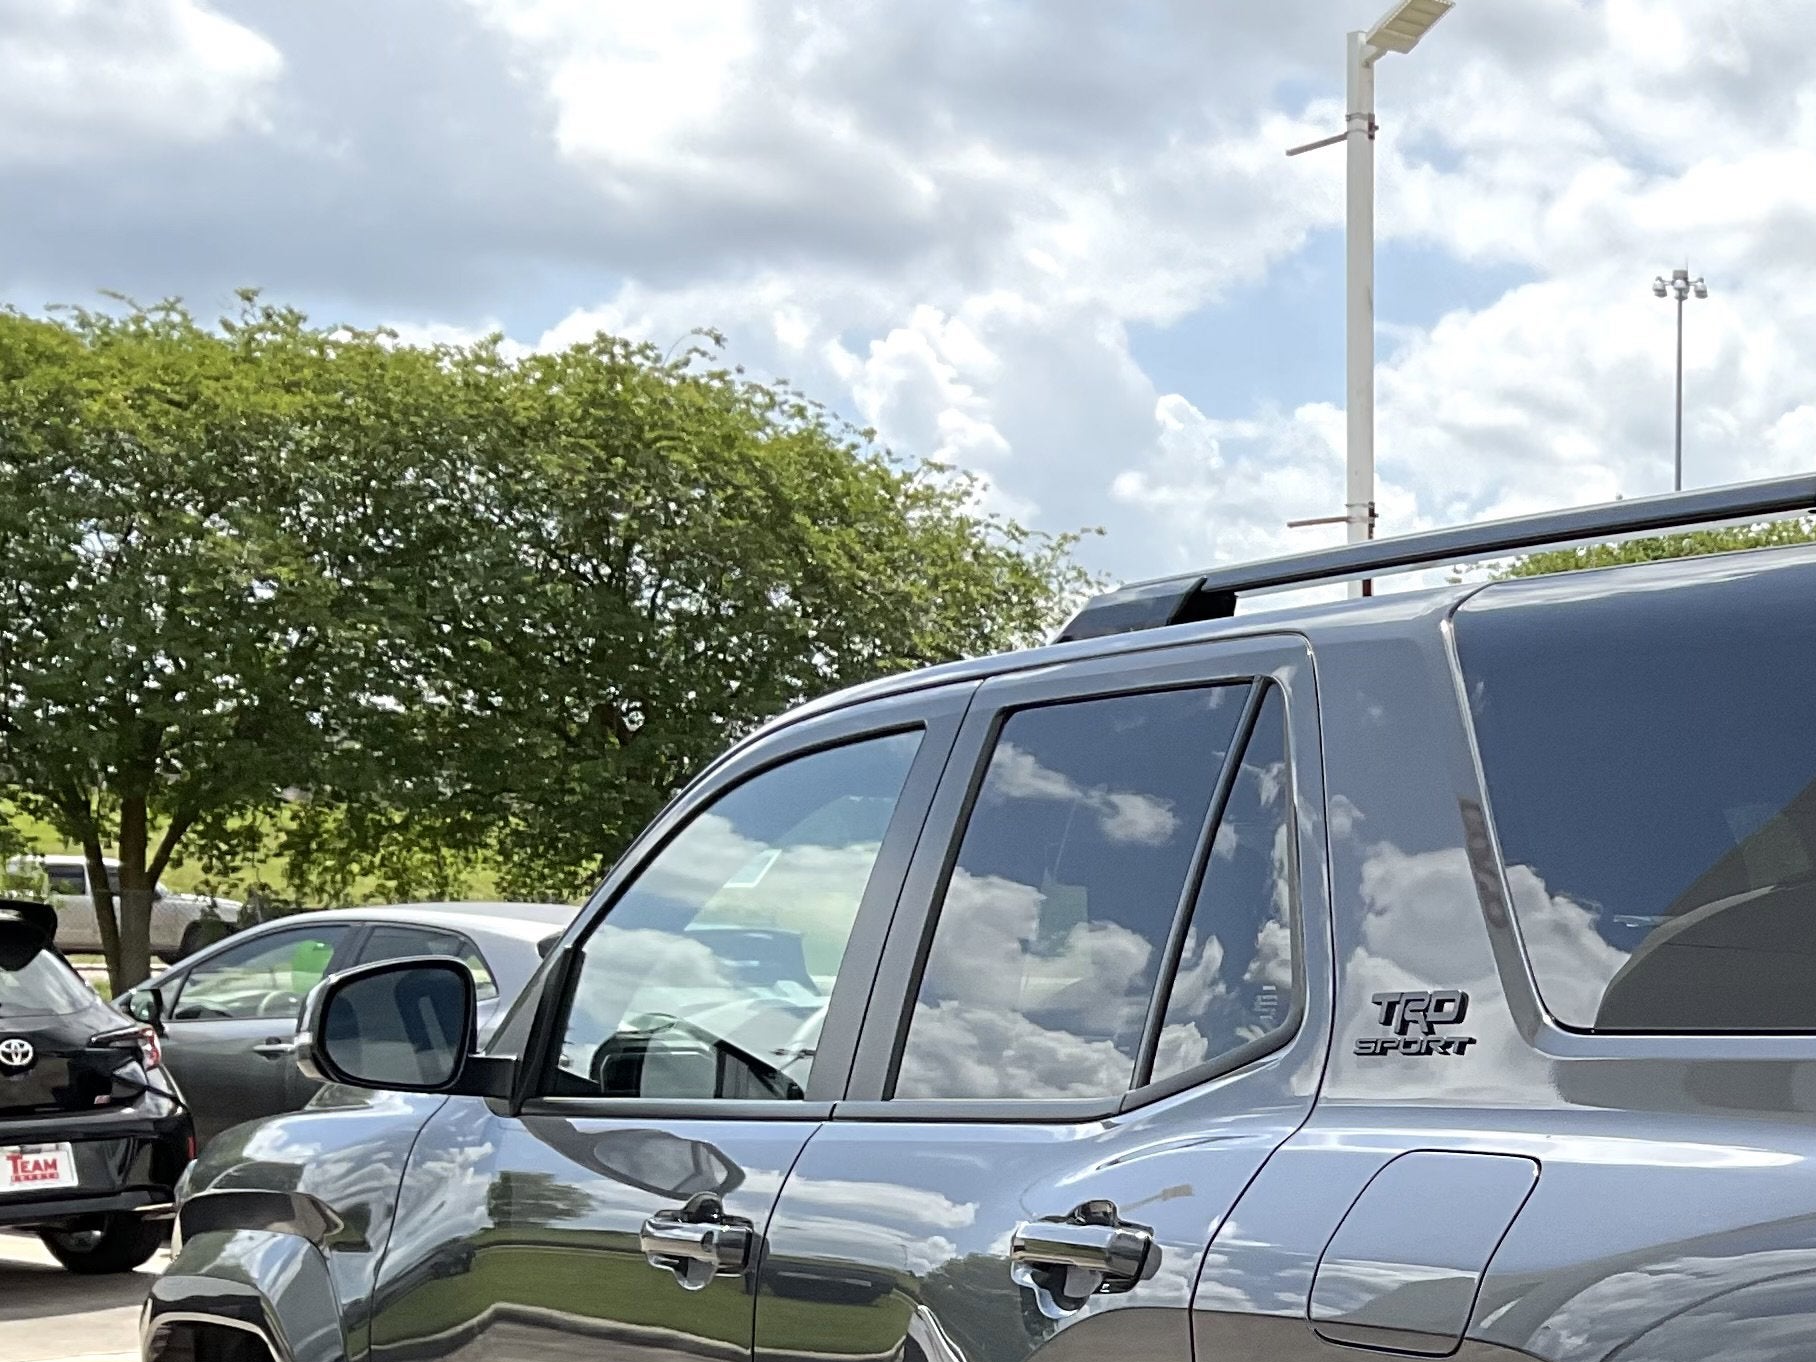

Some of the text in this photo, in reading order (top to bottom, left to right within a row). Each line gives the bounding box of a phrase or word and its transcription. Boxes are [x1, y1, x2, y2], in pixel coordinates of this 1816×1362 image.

[1372, 990, 1469, 1036] TRD
[1353, 1036, 1477, 1056] SPORT
[7, 1154, 57, 1175] TEAM
